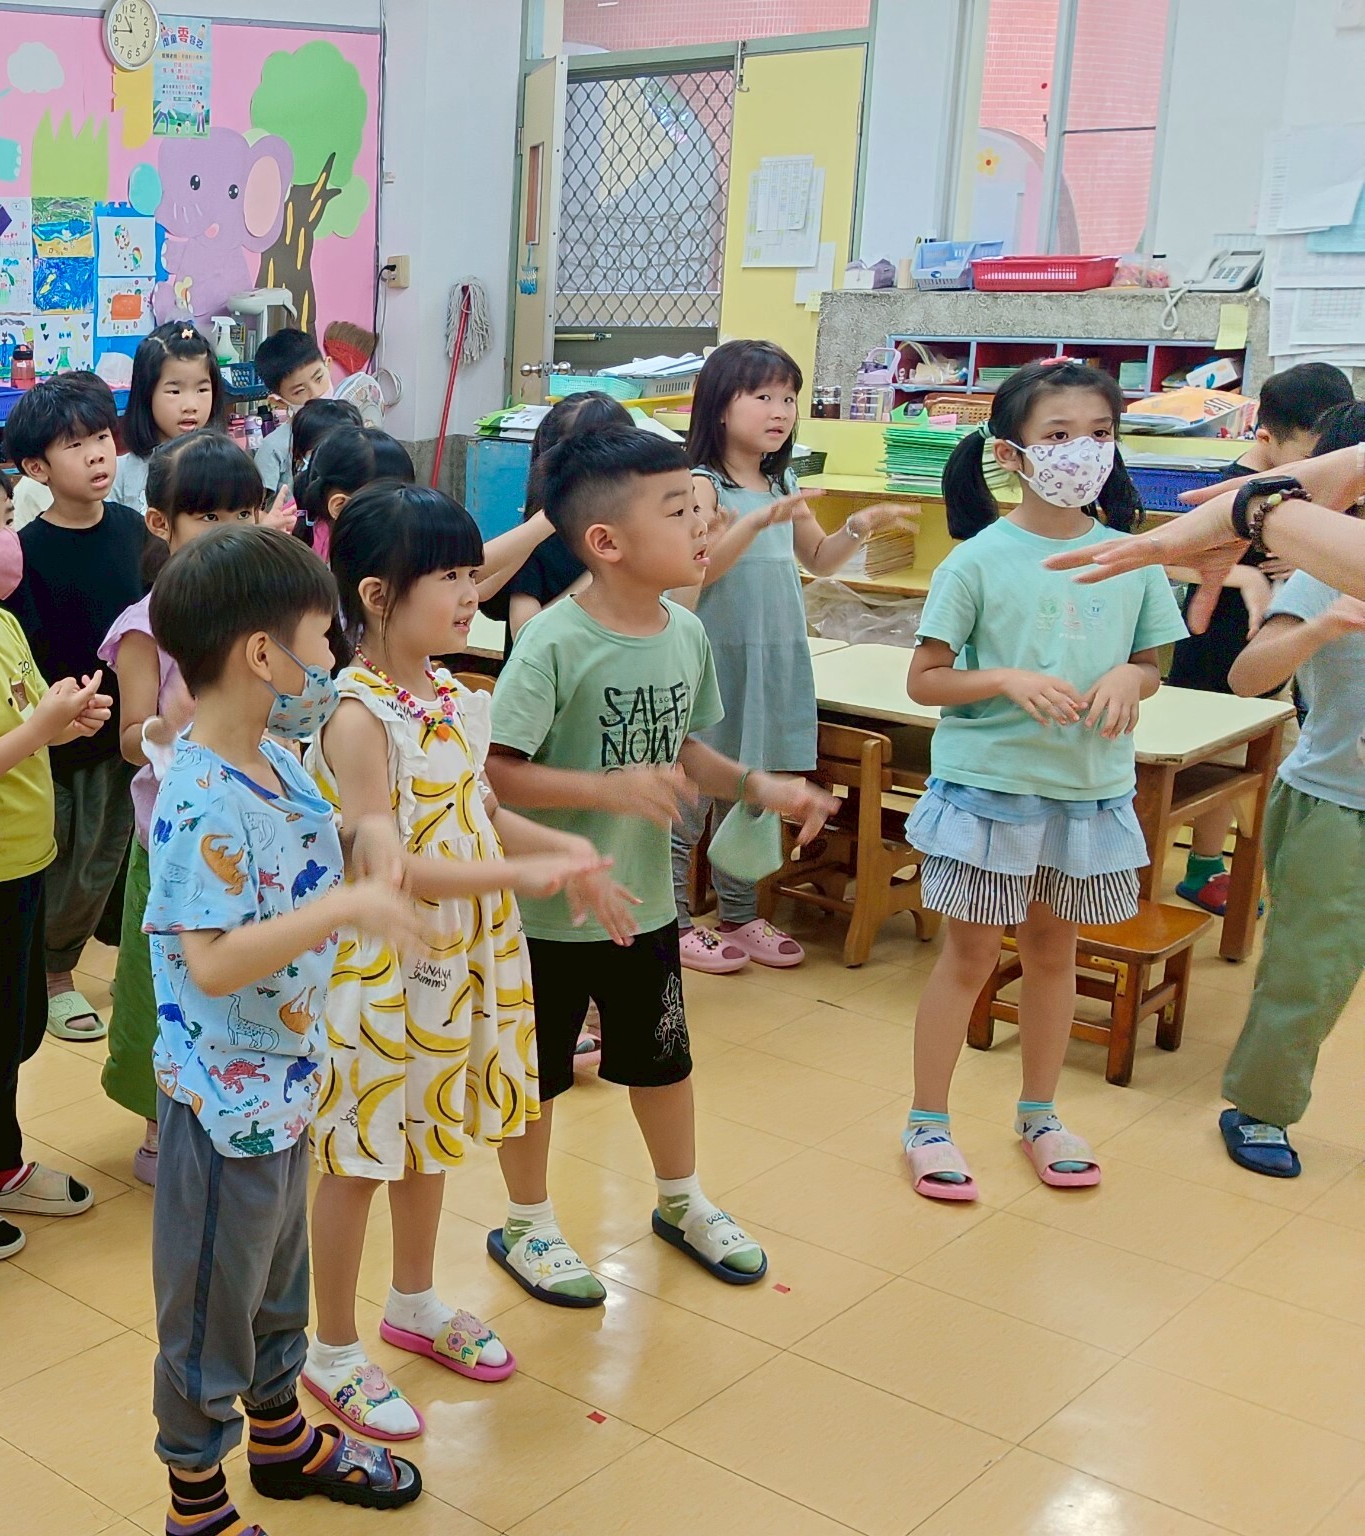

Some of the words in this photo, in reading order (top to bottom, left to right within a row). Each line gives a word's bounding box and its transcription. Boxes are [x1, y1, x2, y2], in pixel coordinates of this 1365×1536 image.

[122, 4, 128, 14] 11
[129, 3, 137, 13] 12
[140, 7, 144, 16] 1
[115, 13, 123, 23] 10
[143, 16, 149, 26] 2
[112, 24, 118, 34] 9
[144, 28, 150, 38] 3
[114, 36, 120, 46] 8
[141, 40, 147, 49] 4
[119, 45, 125, 55] 7
[126, 50, 133, 59] 6
[135, 47, 141, 57] 5
[602, 723, 677, 767] NOW
[415, 959, 451, 981] BANANA
